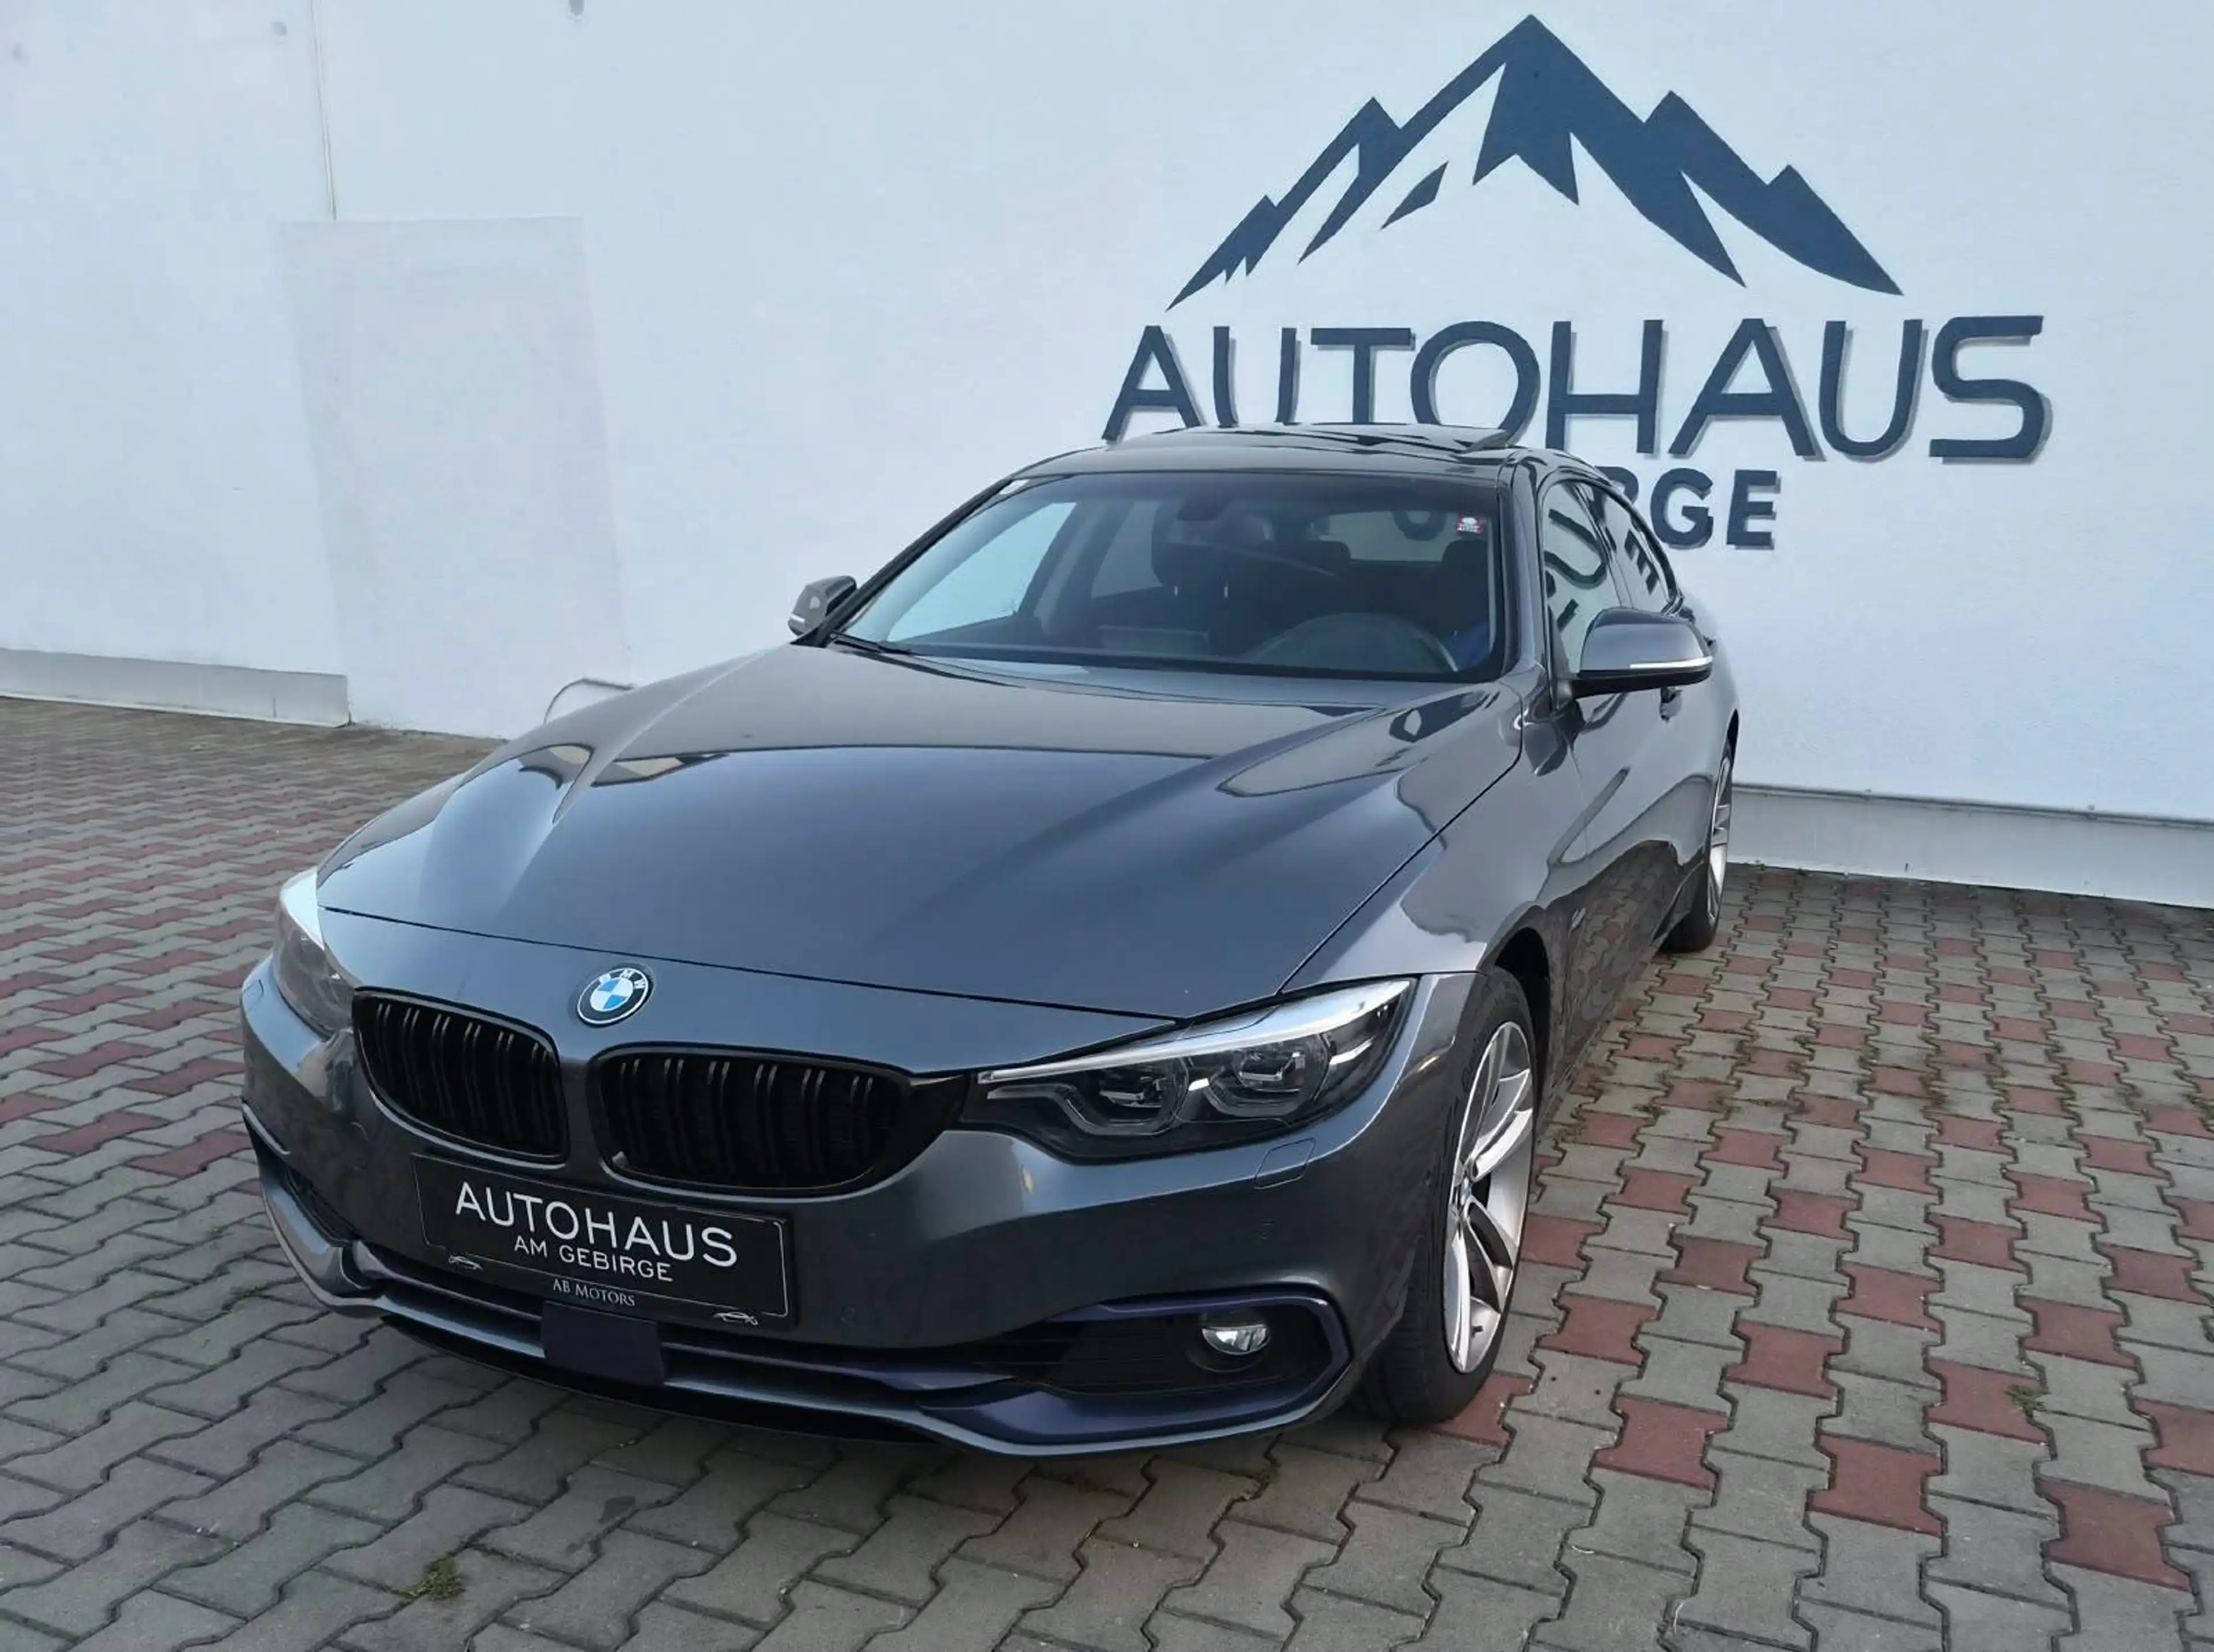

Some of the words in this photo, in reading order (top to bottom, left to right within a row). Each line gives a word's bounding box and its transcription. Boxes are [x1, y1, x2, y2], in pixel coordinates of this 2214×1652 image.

[1101, 315, 2046, 459] AUTOHAUS
[455, 1181, 737, 1267] AUTOHAUS
[514, 1234, 548, 1258] AM
[559, 1244, 673, 1282] GEBIRGE
[553, 1278, 571, 1293] AB
[575, 1284, 635, 1307] MOTORS
